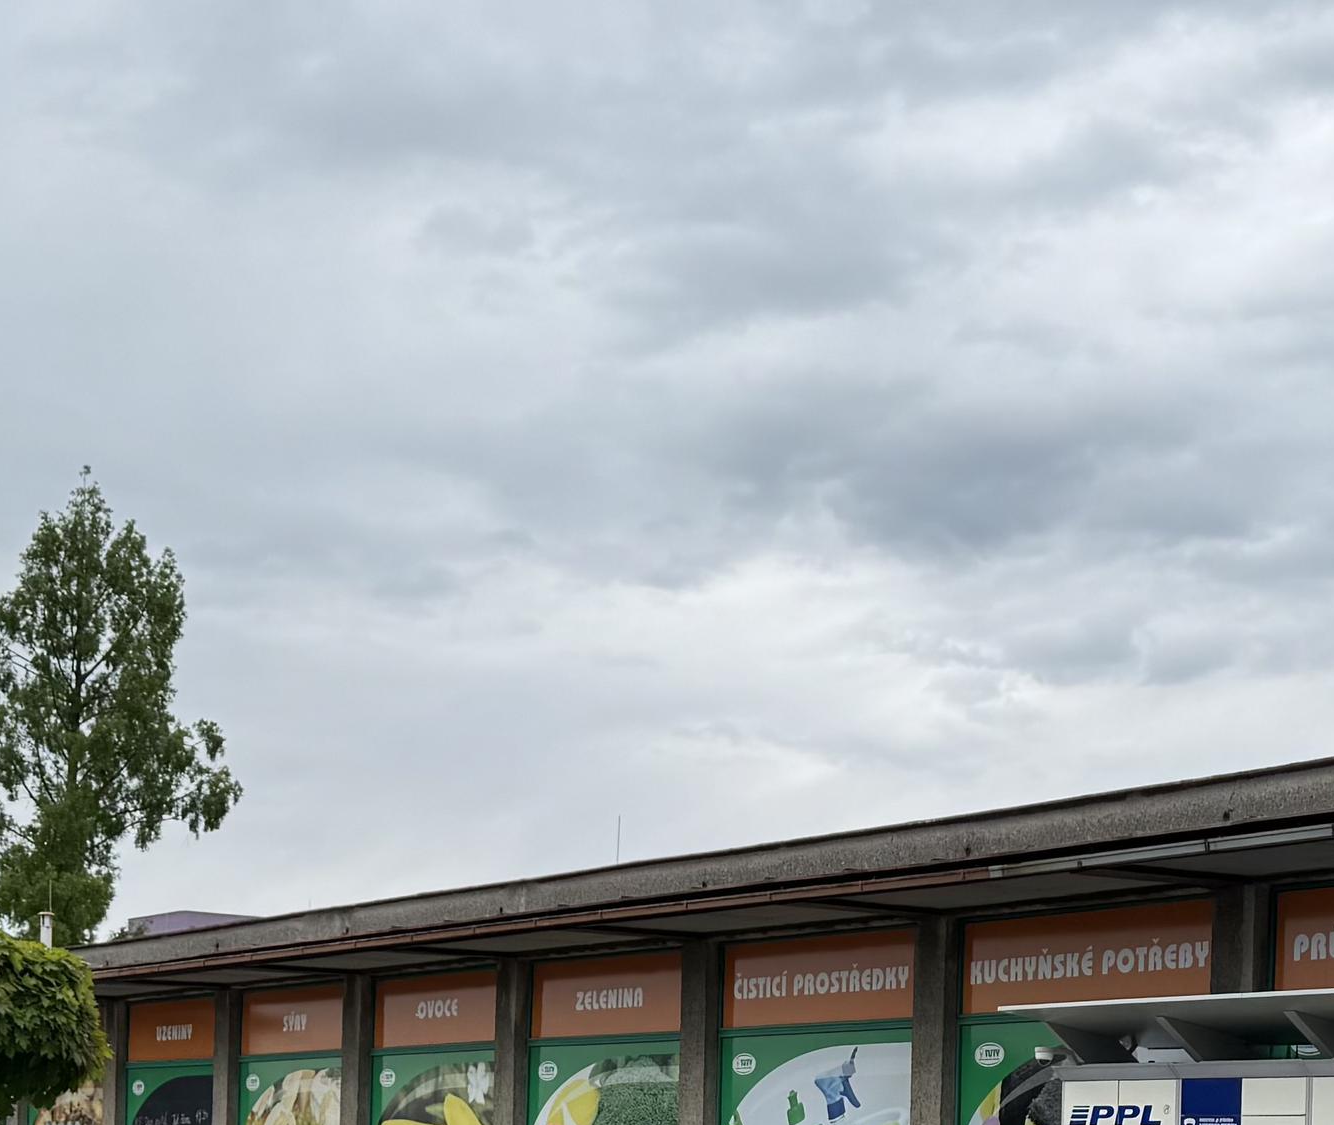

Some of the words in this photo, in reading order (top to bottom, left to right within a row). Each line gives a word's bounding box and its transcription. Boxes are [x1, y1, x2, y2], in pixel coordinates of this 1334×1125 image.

[970, 945, 1093, 985] KUCHYŇSKÉ
[1102, 938, 1210, 976] POTŘEBY
[733, 970, 788, 1000] ČISTICÍ
[793, 963, 909, 997] PROSTŘEDKY
[417, 999, 459, 1020] OVOCE
[575, 987, 644, 1011] ZELENINA
[156, 1024, 193, 1041] UZENINY
[282, 1011, 307, 1032] SÝNY
